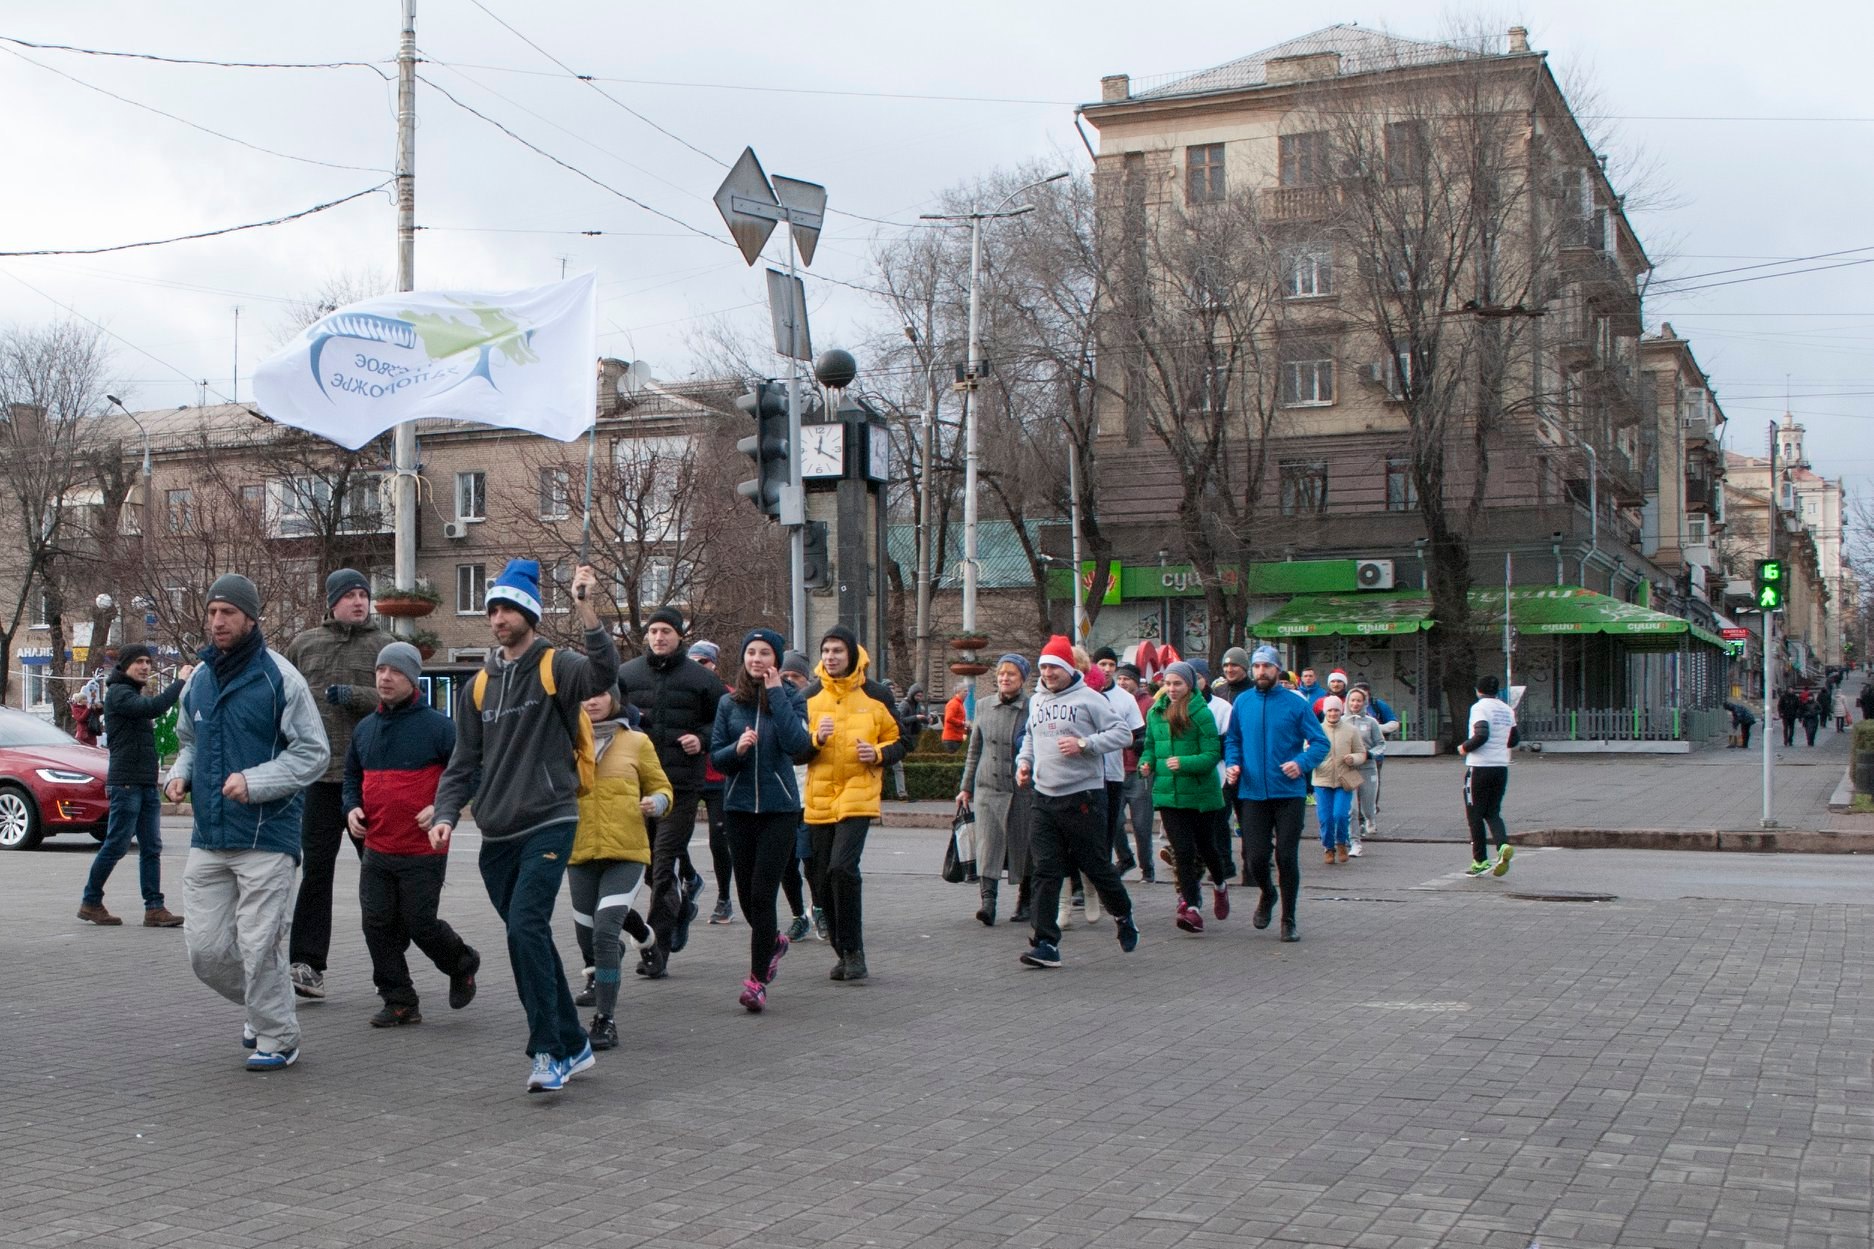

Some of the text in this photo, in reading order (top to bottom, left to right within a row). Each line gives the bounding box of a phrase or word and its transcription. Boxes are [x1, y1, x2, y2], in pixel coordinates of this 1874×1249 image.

[815, 466, 823, 474] 6
[1764, 563, 1779, 579] 16
[1032, 703, 1077, 728] LONDON
